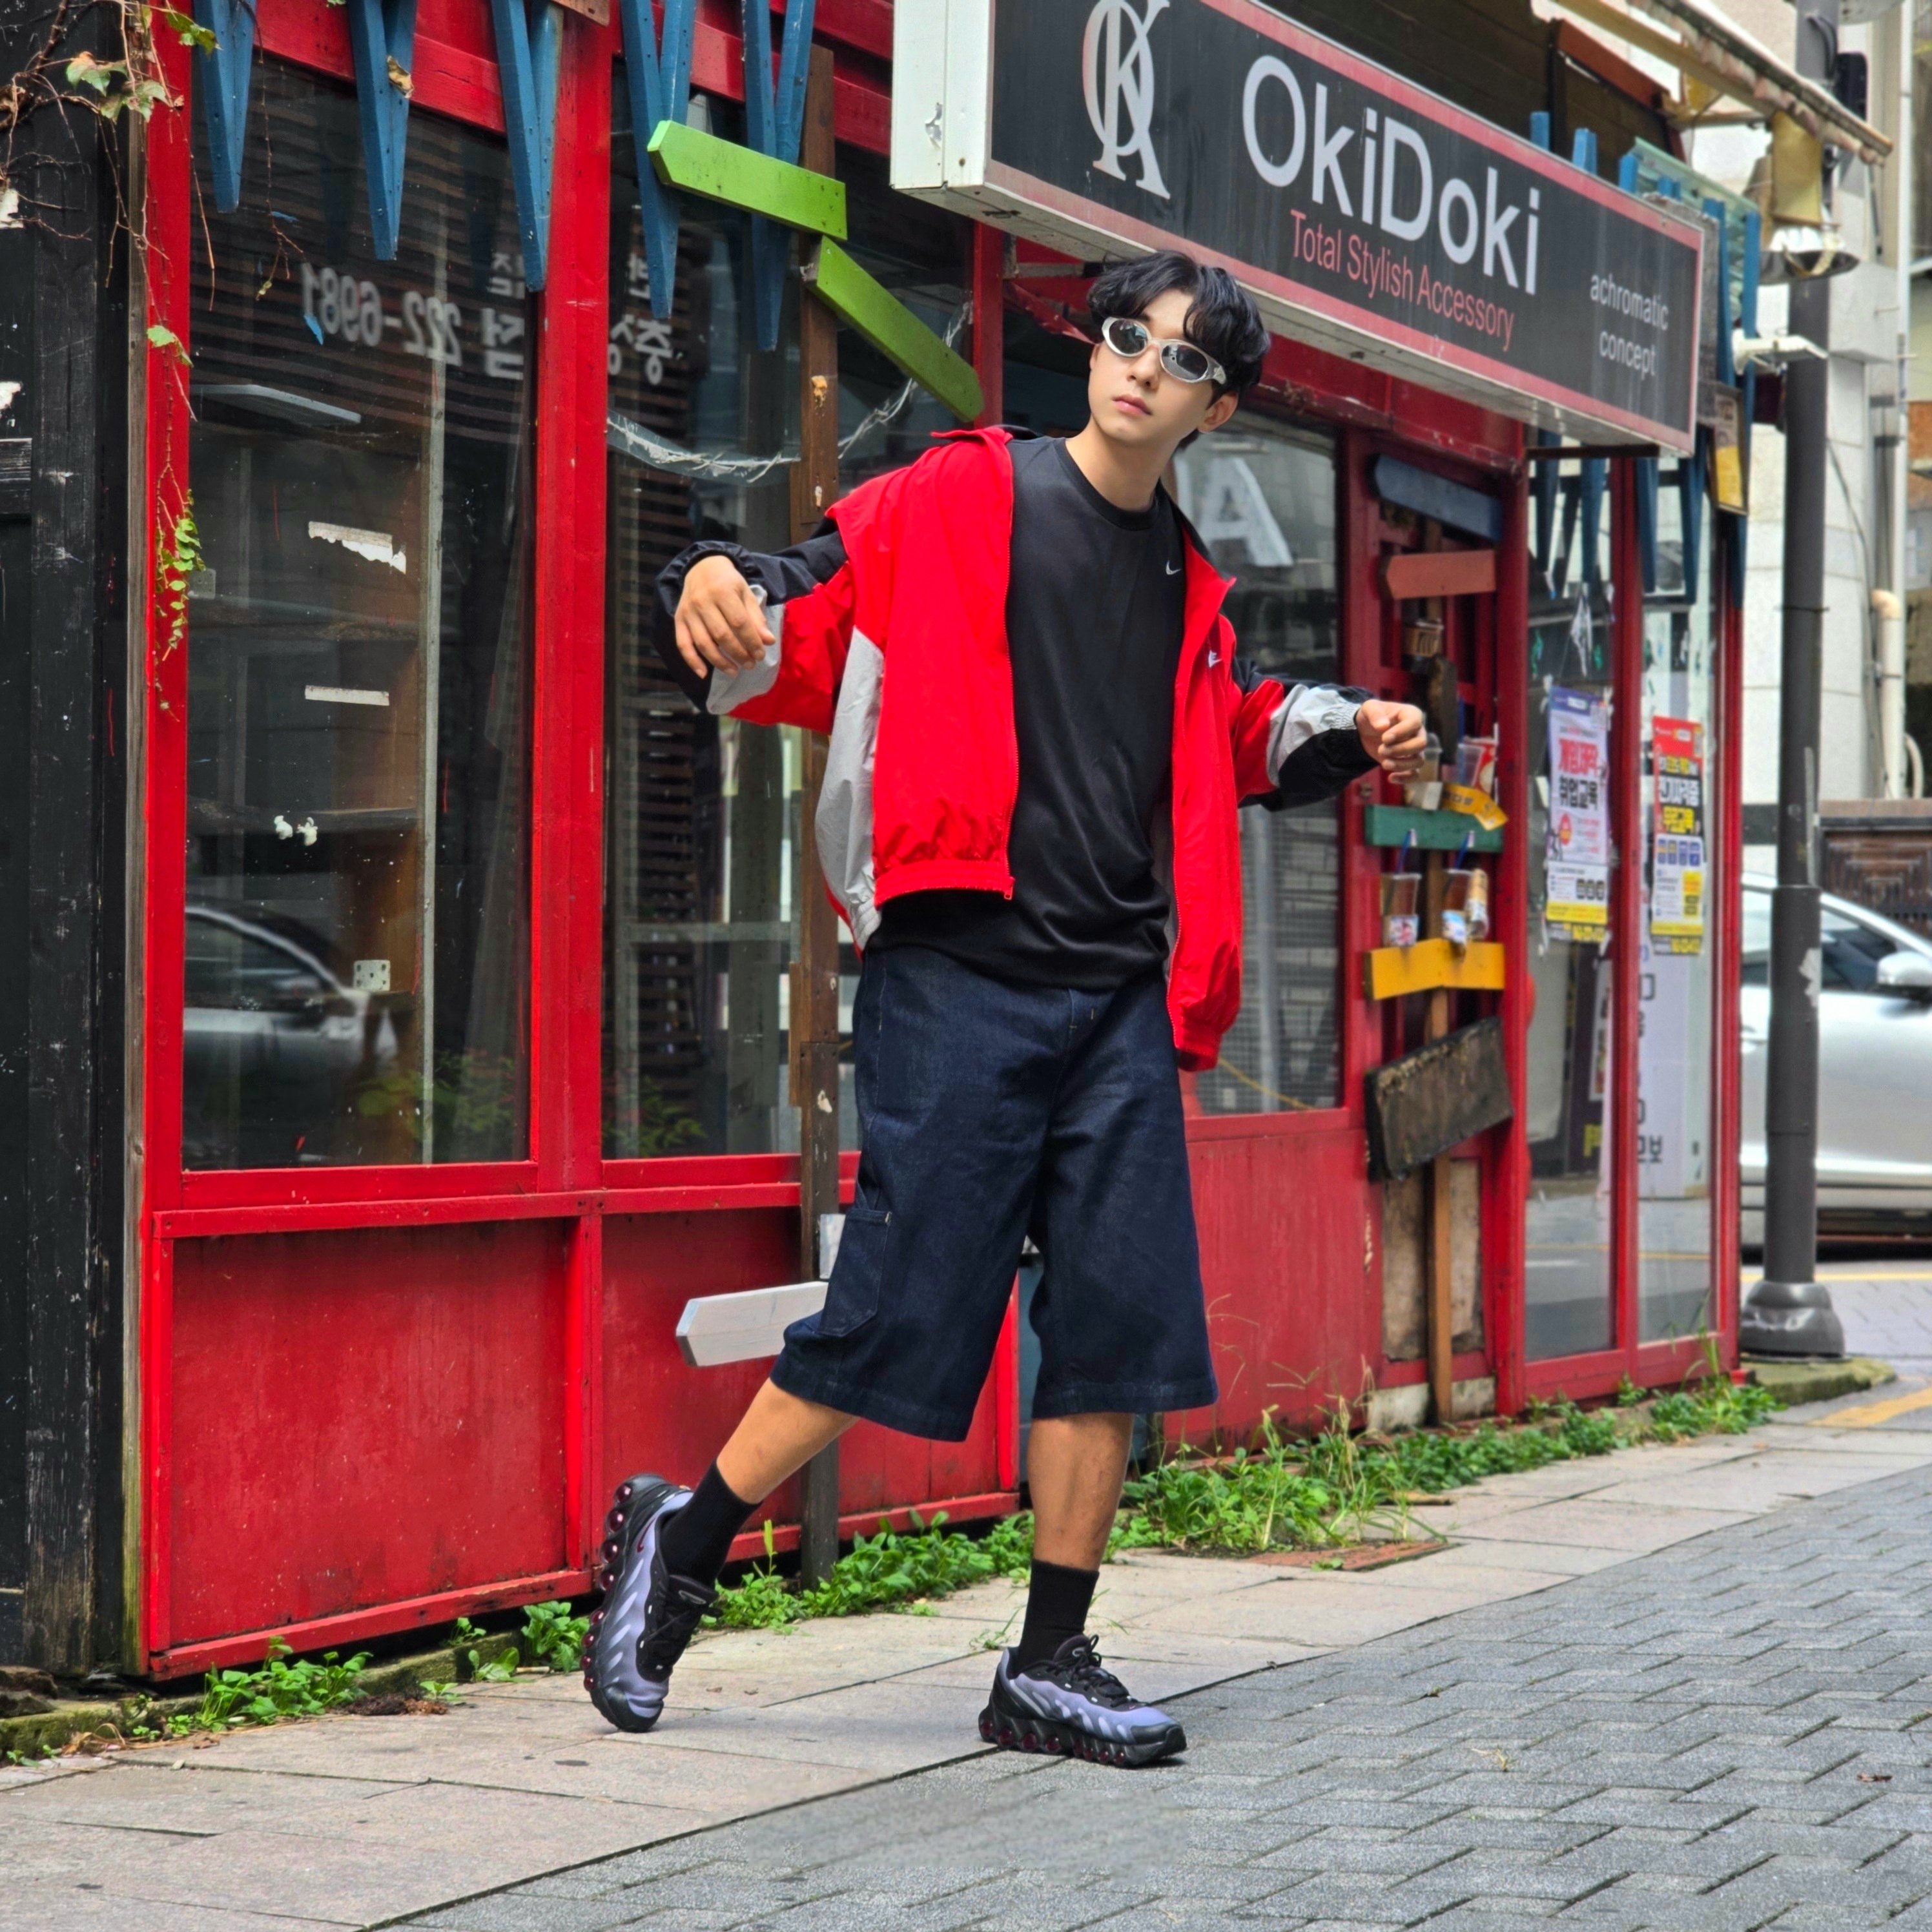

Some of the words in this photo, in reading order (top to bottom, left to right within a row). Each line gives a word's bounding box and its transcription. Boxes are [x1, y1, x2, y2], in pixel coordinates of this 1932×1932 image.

[1242, 54, 1541, 296] OkiDoki
[1290, 209, 1342, 273] Total
[1347, 234, 1413, 303] Stylish
[1417, 264, 1515, 353] Accessory
[1590, 273, 1669, 331] achromatic
[1599, 331, 1656, 380] concept
